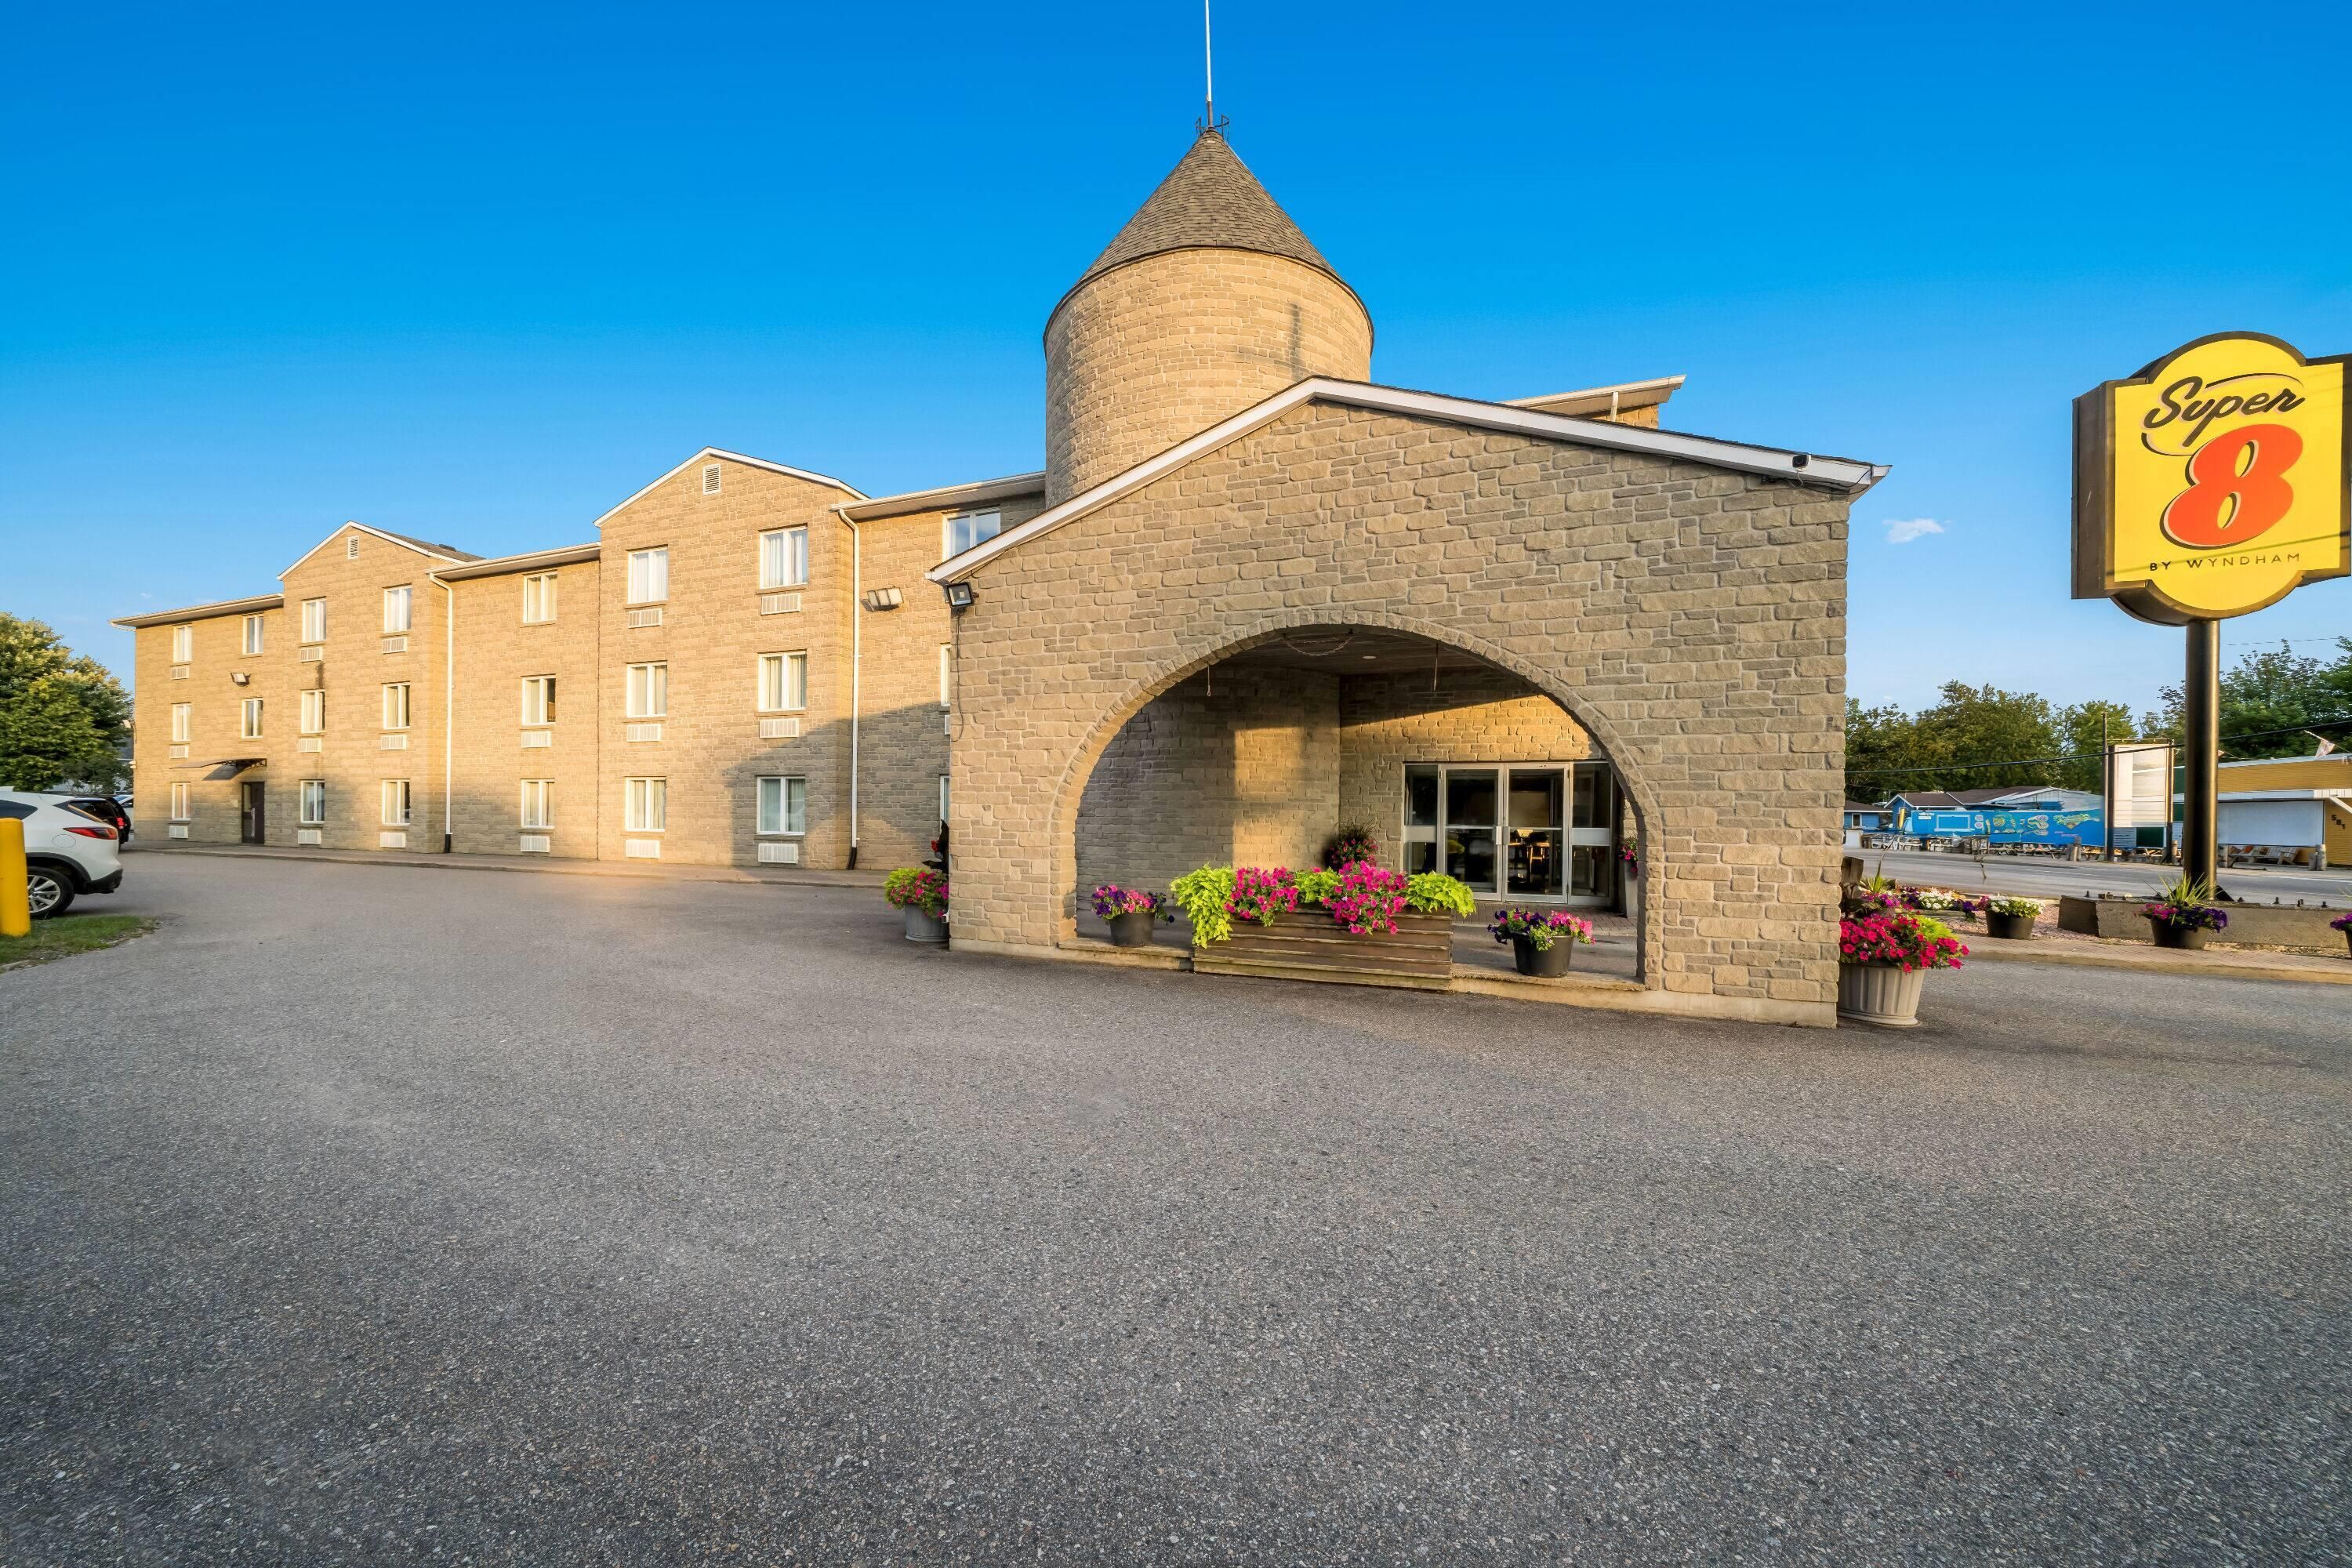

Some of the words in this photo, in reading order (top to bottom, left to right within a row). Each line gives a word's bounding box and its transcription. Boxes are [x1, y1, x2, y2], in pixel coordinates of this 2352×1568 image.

[2143, 376, 2306, 448] Super
[2159, 423, 2303, 550] 8
[2149, 561, 2172, 571] BY
[2187, 553, 2299, 568] WYNDHAM
